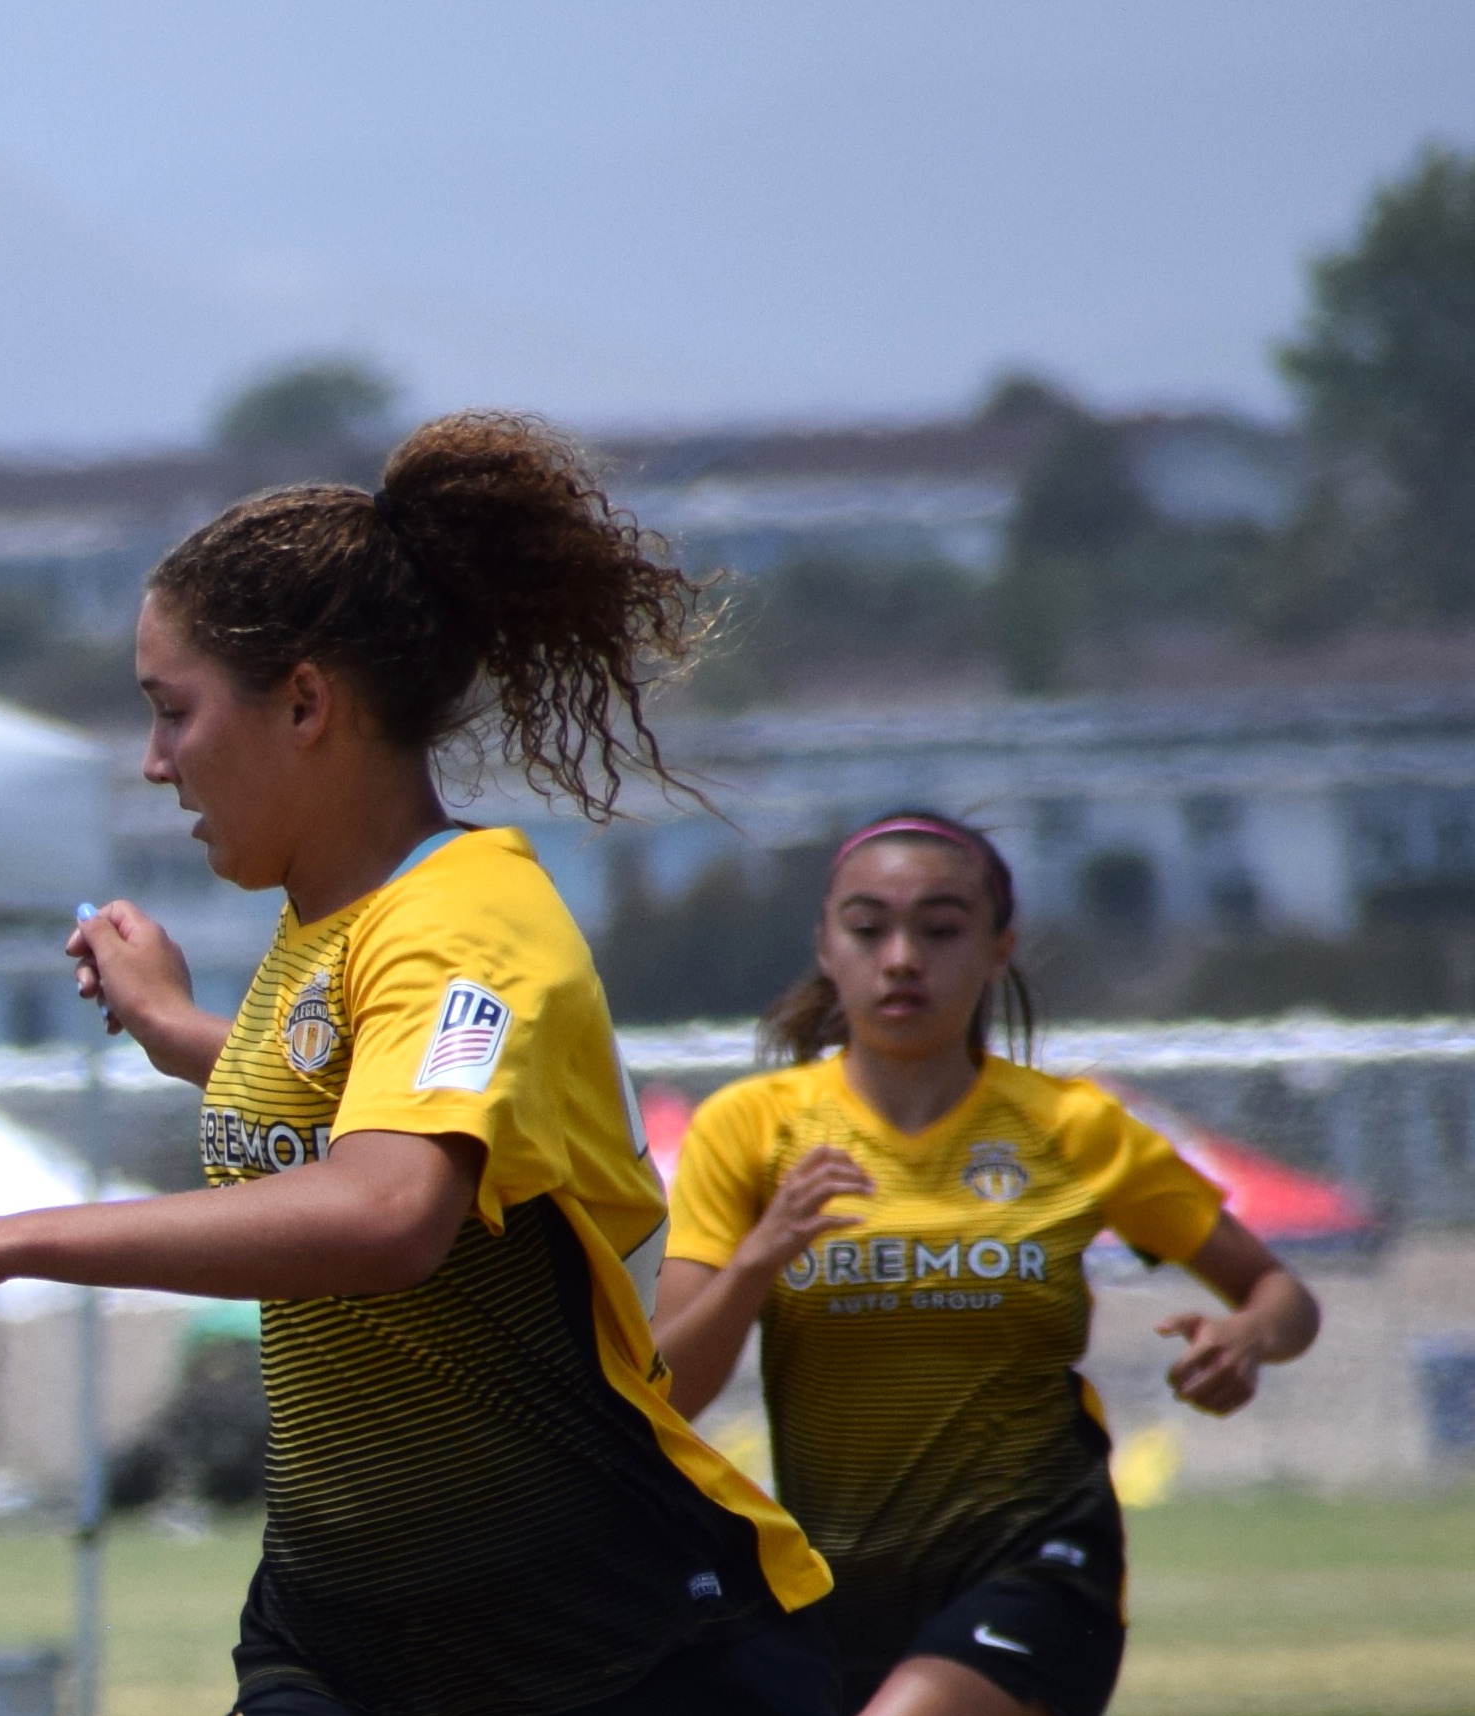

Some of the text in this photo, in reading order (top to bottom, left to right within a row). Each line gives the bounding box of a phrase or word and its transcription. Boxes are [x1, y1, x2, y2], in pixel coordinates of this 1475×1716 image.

[200, 1107, 334, 1173] REMO
[827, 1292, 1004, 1313] AUTO GROUP
